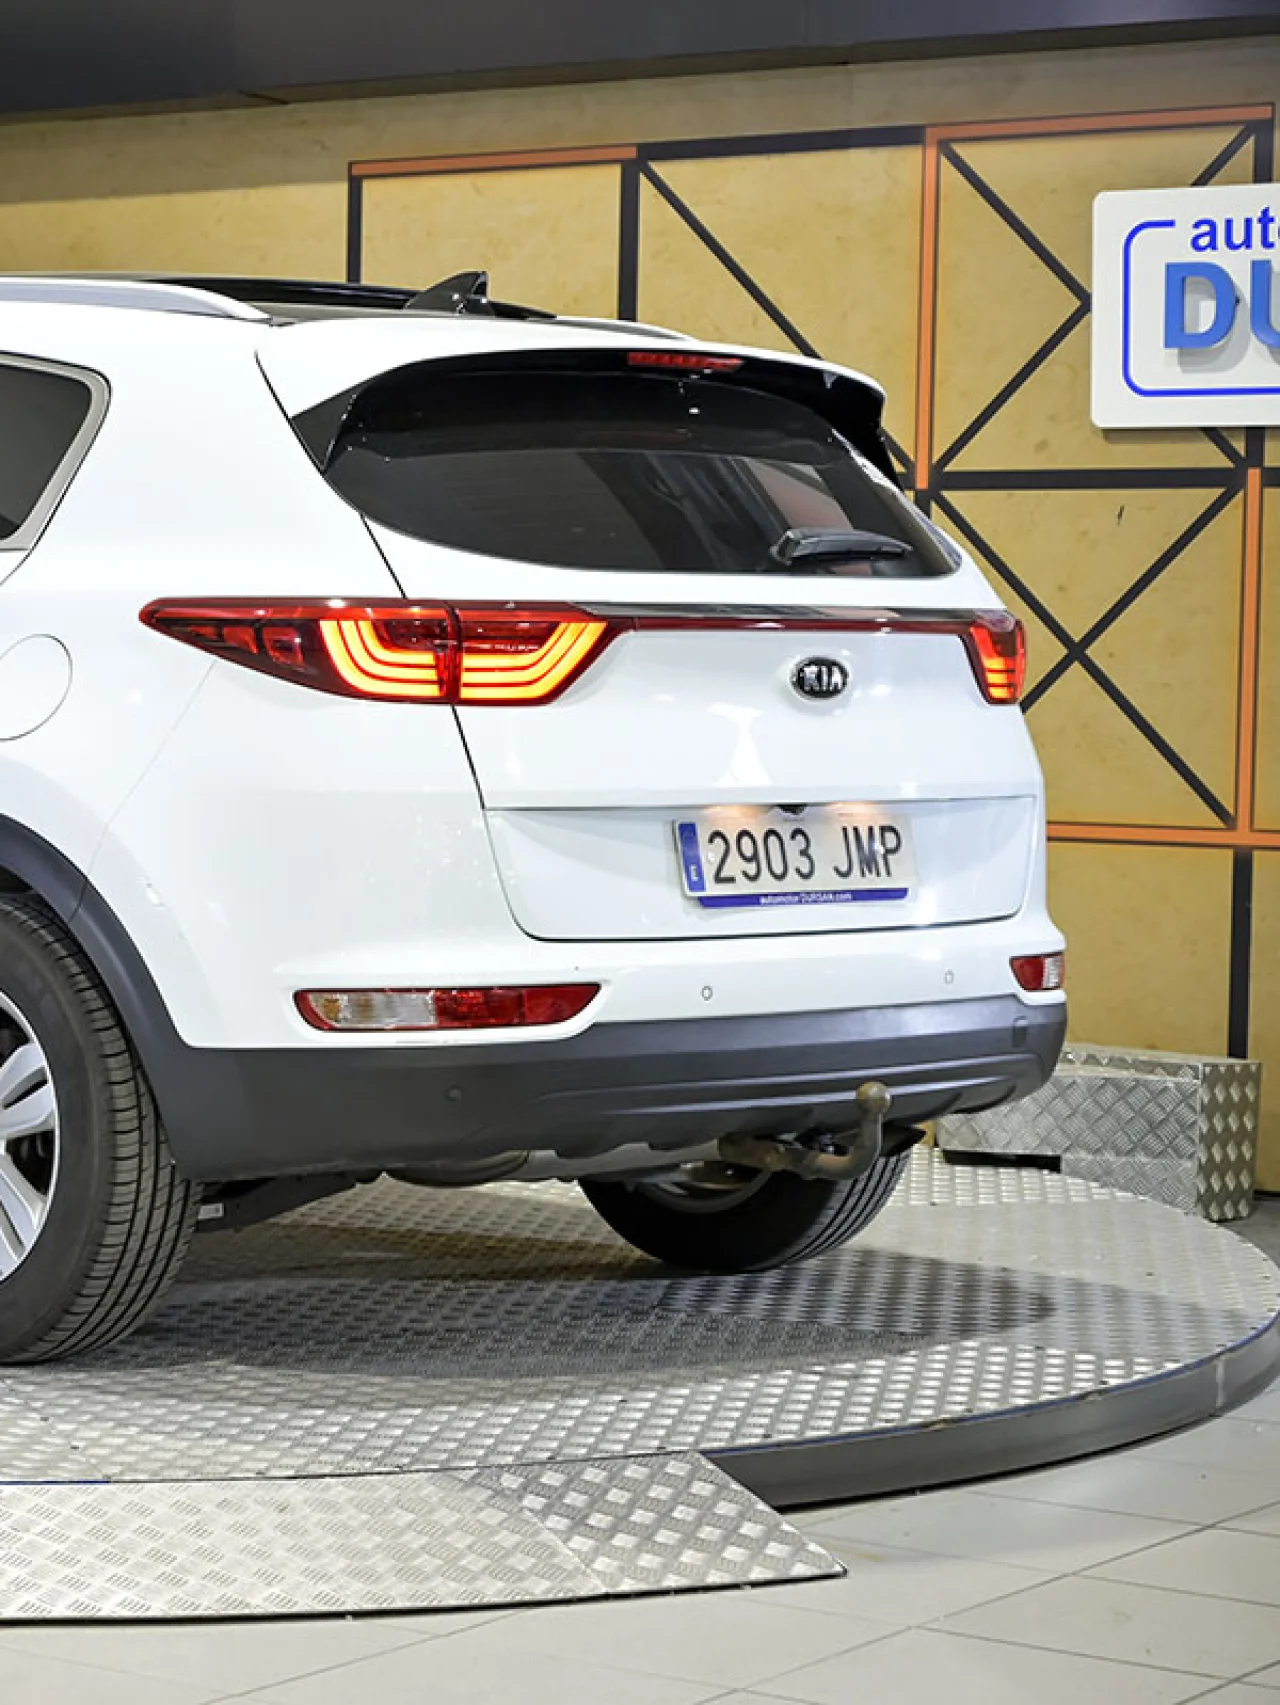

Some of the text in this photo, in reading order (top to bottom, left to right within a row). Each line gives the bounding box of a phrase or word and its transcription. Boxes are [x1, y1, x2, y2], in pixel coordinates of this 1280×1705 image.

[1190, 206, 1280, 252] aut
[800, 664, 843, 693] KIA
[707, 828, 816, 884] 2903
[833, 825, 903, 880] JMP
